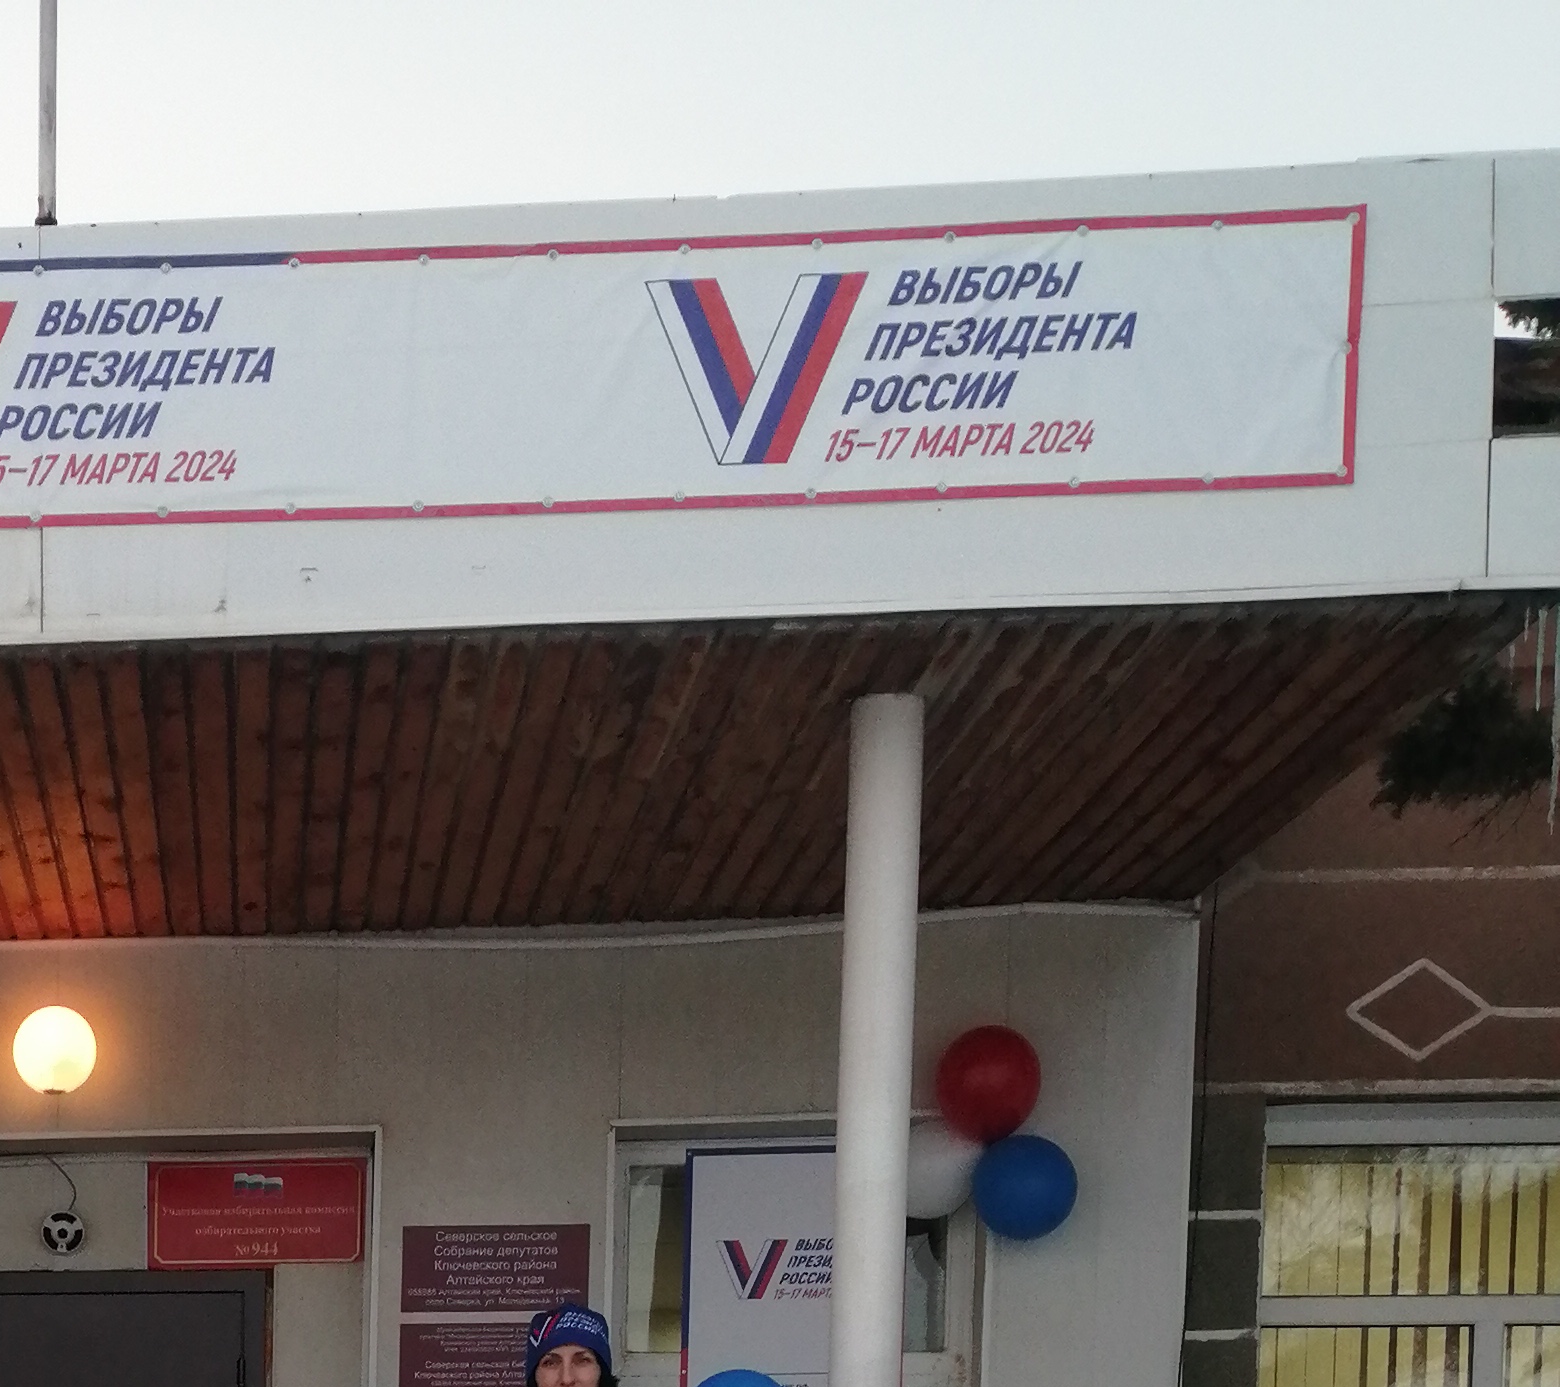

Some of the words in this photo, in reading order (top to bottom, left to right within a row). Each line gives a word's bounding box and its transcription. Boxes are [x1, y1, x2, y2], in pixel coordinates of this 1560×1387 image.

[888, 261, 1083, 306] ВЫБОРЫ
[35, 297, 222, 337] ВЫБОРЫ
[864, 311, 1138, 361] ПРЕЗИДЕНТА
[13, 347, 275, 392] ПРЕЗИДЕНТА
[842, 370, 1019, 415] РОССИИ
[910, 422, 1016, 459] МАРТА
[1020, 420, 1094, 455] 2024
[62, 452, 156, 486] МАРТА
[165, 449, 236, 483] 2024
[435, 1231, 499, 1243] Северское
[503, 1231, 557, 1241] сельское
[795, 1238, 834, 1250] ВЫБО
[434, 1245, 493, 1258] Собрание
[497, 1247, 558, 1258] депутатов
[787, 1255, 833, 1268] ПРЕЗИ
[434, 1260, 510, 1271] Ключевского
[514, 1258, 557, 1271] района
[446, 1274, 513, 1285] Алтайского
[517, 1276, 544, 1285] края
[802, 1287, 832, 1299] МАРТ
